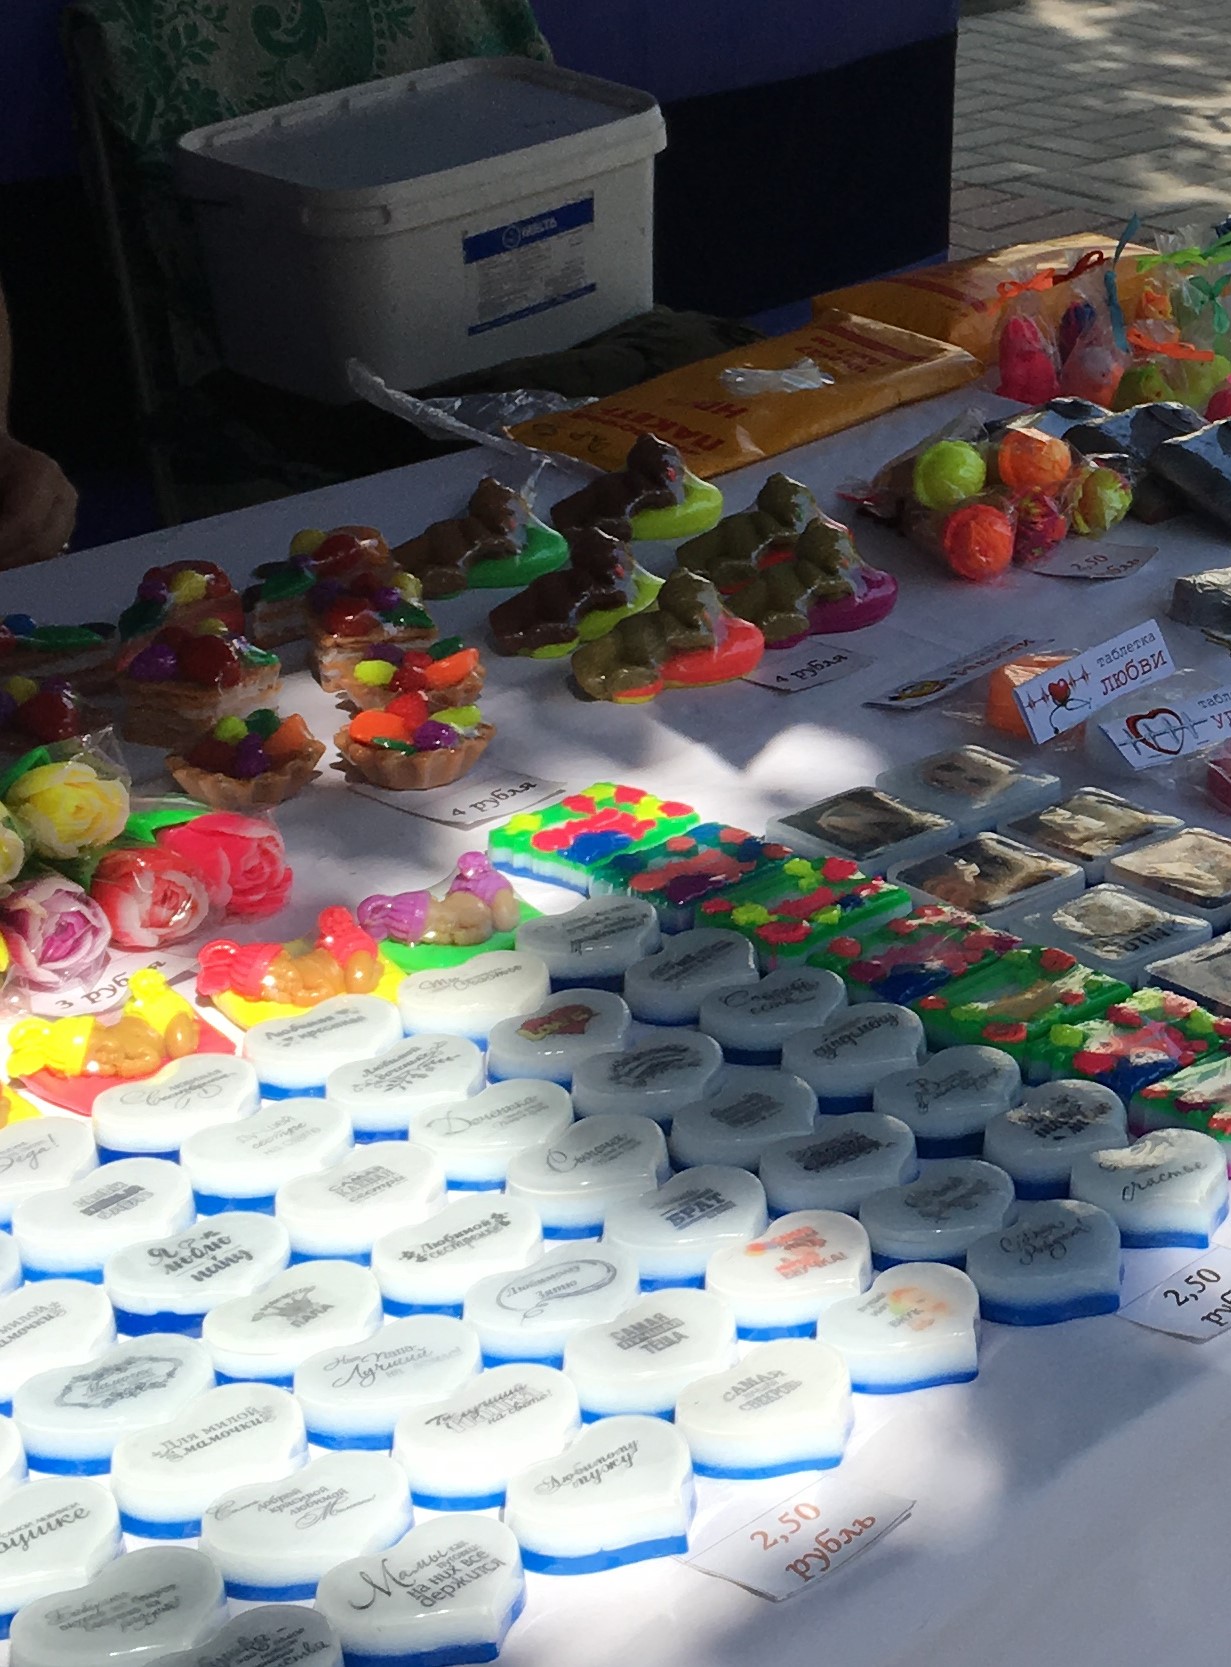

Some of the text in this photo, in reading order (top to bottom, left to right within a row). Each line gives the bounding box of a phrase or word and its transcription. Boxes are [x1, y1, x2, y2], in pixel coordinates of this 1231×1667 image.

[790, 653, 848, 680] рубля
[1096, 632, 1155, 668] таблетка
[469, 782, 537, 812] рубля
[55, 959, 167, 1010] 3 рубя
[147, 1241, 178, 1266] Я
[1163, 1268, 1220, 1306] 2,50
[610, 1313, 671, 1341] САМАЯ
[723, 1370, 788, 1402] САМАЯ
[162, 1405, 262, 1451] Для милой
[184, 1416, 262, 1455] мамочки
[750, 1502, 821, 1550] 2,50
[785, 1515, 876, 1582] рубль
[407, 1577, 431, 1600] на
[432, 1561, 460, 1588] них
[419, 1558, 506, 1607] держится
